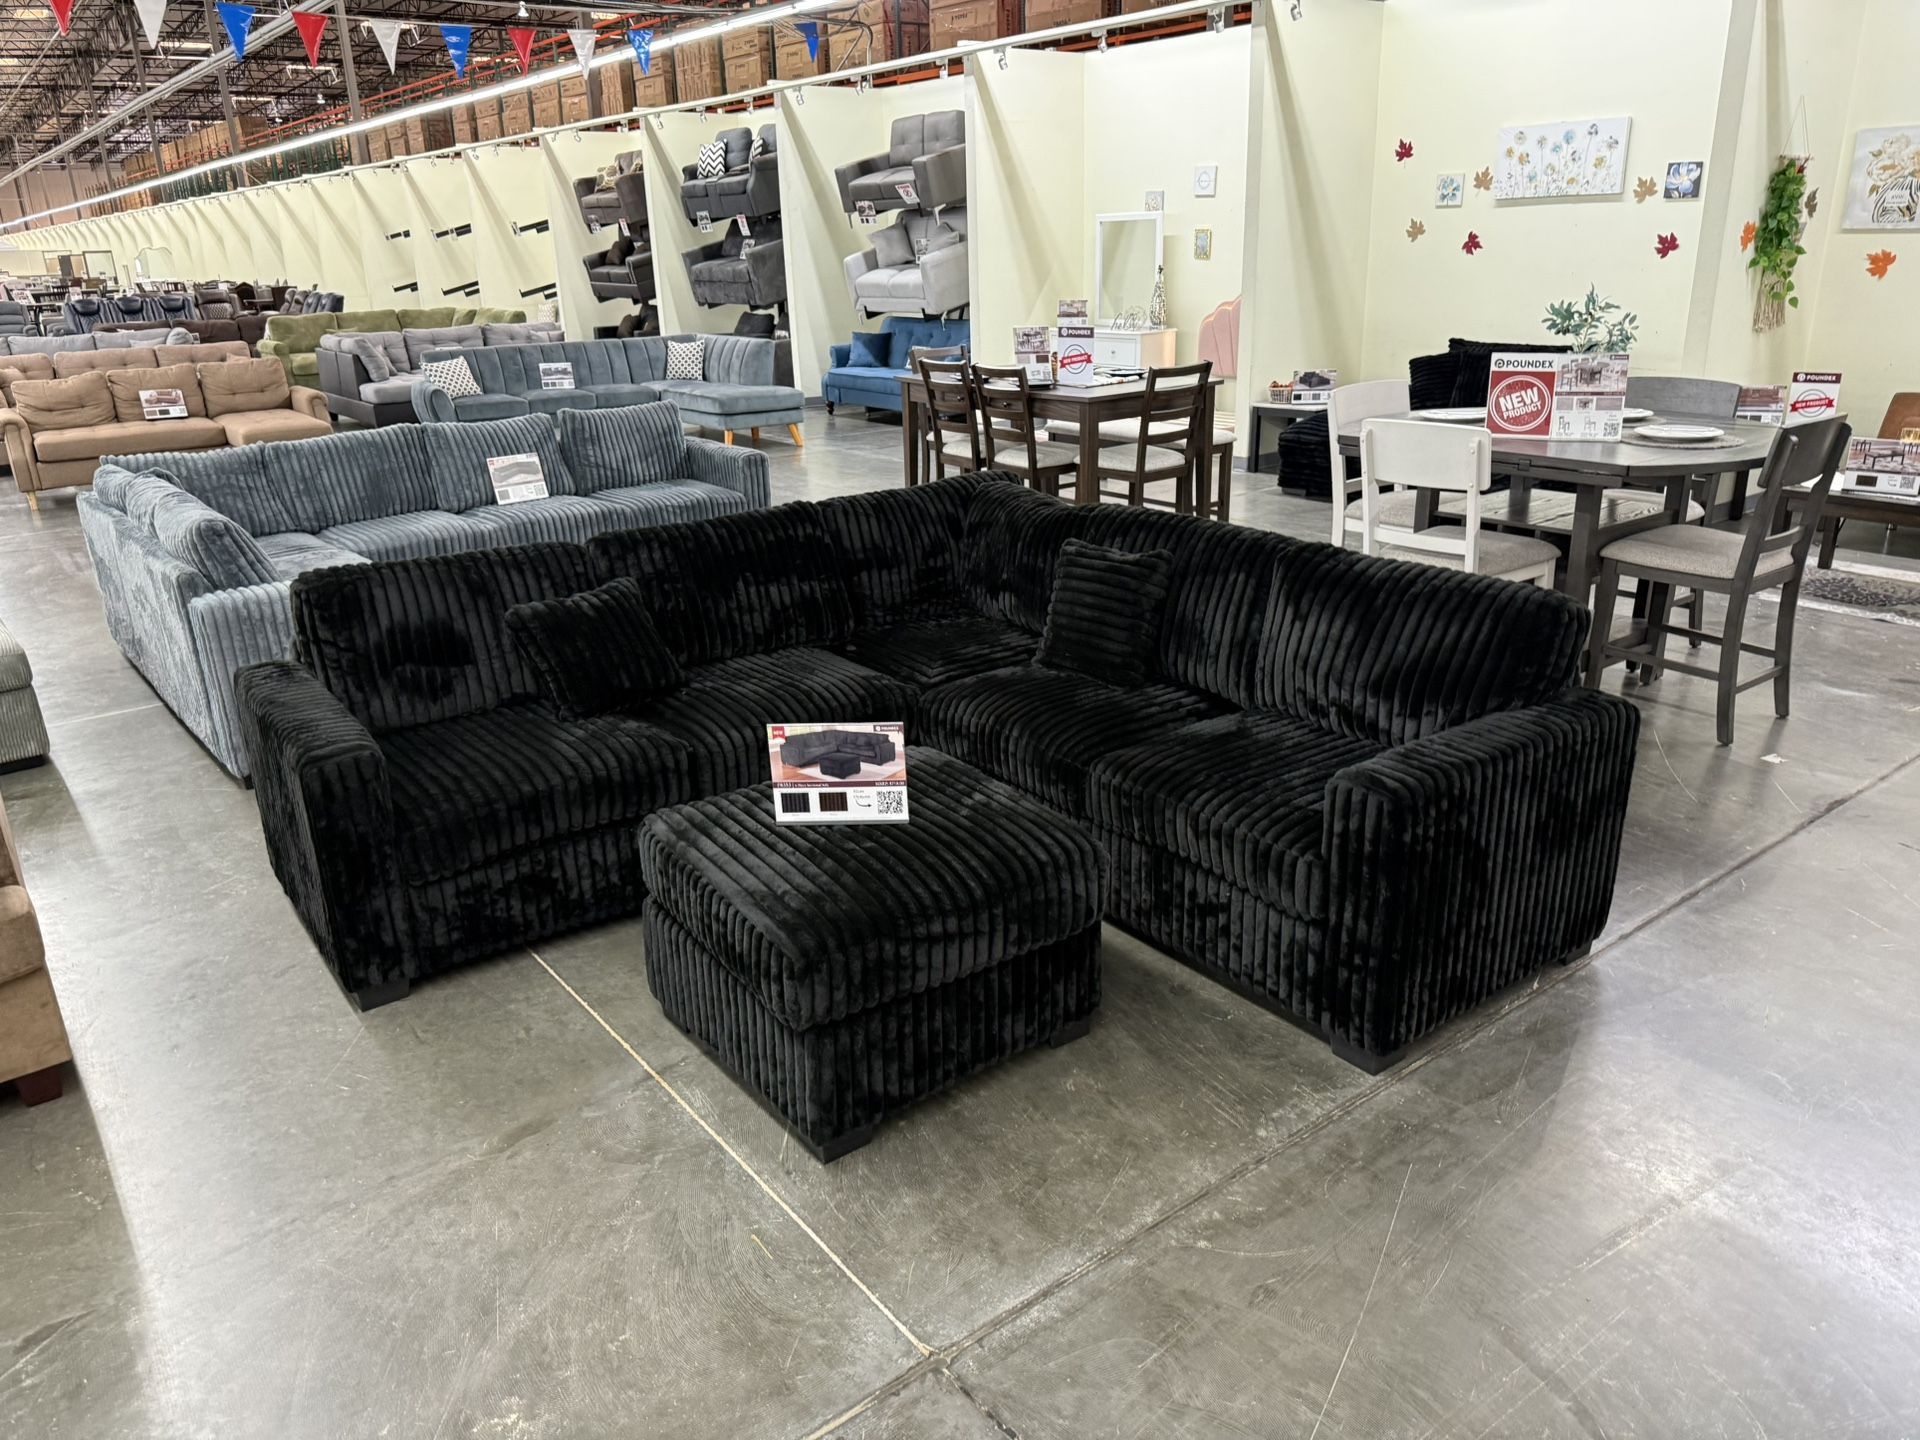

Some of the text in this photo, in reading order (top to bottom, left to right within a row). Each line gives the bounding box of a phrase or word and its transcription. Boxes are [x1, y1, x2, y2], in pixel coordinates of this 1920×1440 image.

[1506, 360, 1553, 369] POUNDEX
[1499, 387, 1539, 412] NEW
[1503, 402, 1542, 420] PRODUCT
